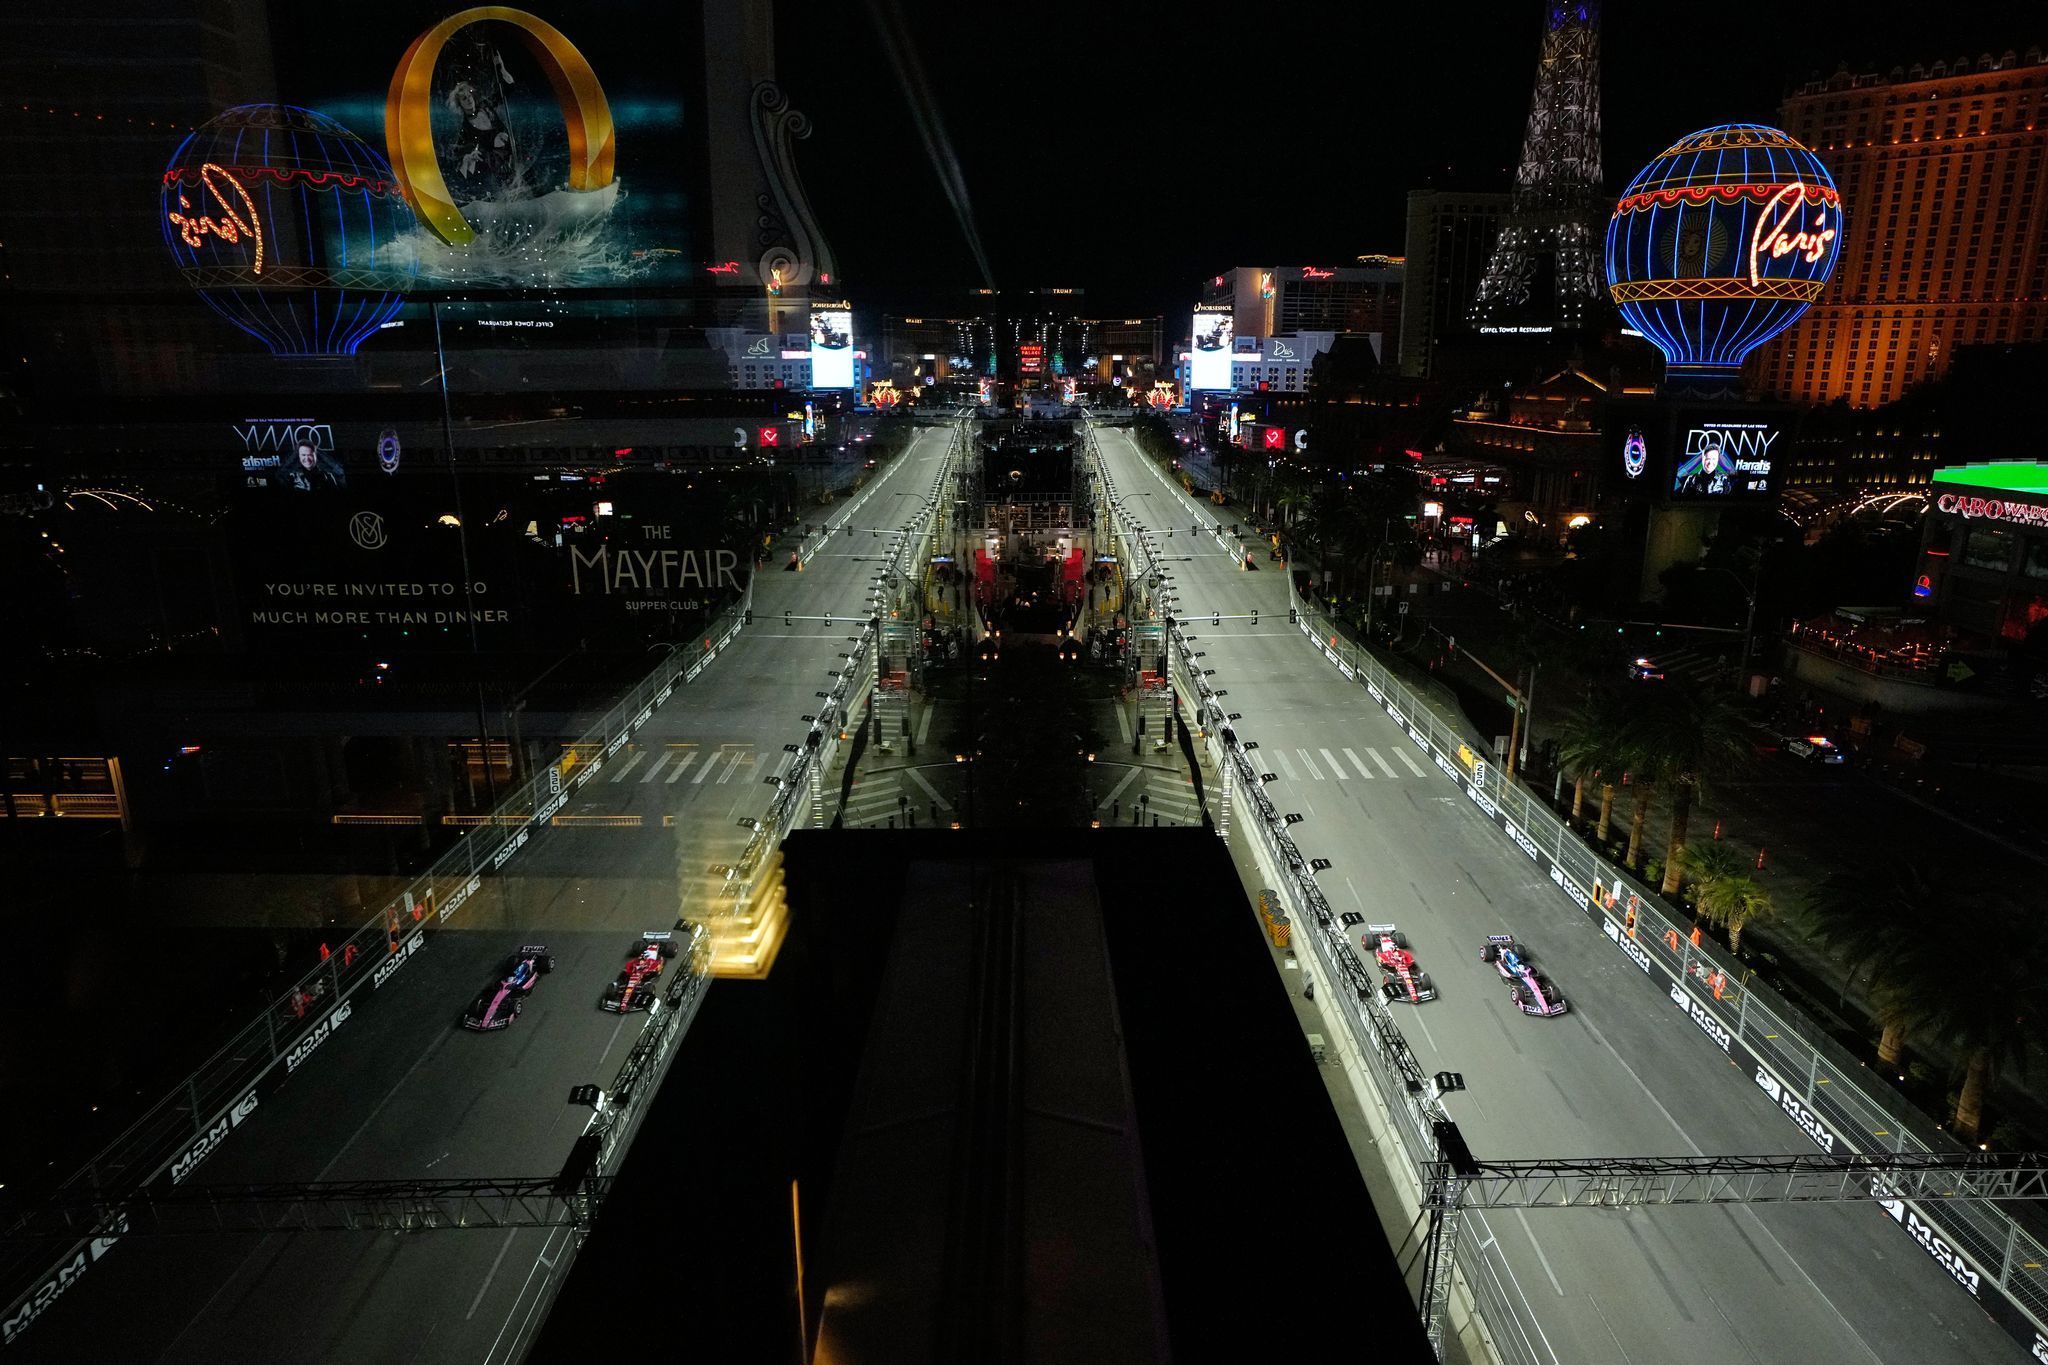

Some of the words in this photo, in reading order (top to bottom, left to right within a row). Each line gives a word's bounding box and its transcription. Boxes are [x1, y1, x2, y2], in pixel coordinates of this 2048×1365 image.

[1750, 182, 1835, 287] Paris
[1686, 429, 1780, 456] DONNY
[1938, 494, 2004, 519] CABO
[641, 525, 672, 540] THE
[569, 545, 744, 595] MAYFAIR
[265, 583, 339, 596] YOU'RE
[345, 583, 424, 596] INVITED
[428, 583, 455, 595] TO
[252, 611, 308, 624] MUCH
[315, 611, 371, 624] MORE
[375, 611, 428, 623] THAN
[435, 610, 509, 624] DINNER
[625, 601, 667, 610] SUPPER
[670, 601, 699, 610] CLUB
[1443, 761, 1458, 780] MGM
[1475, 764, 1484, 786] 250
[1477, 793, 1495, 815] MGM
[1516, 831, 1538, 857] MGM
[1563, 877, 1589, 907] MGM
[1619, 931, 1650, 968] MGM
[1619, 942, 1651, 975] REWARDS
[1691, 1002, 1730, 1046] MGM
[1691, 1012, 1730, 1053] REWARDS
[1782, 1102, 1832, 1154] REWARDS
[1783, 1091, 1833, 1147] MGM
[1907, 1224, 1978, 1296] REWARDS
[1909, 1212, 1980, 1288] MGM
